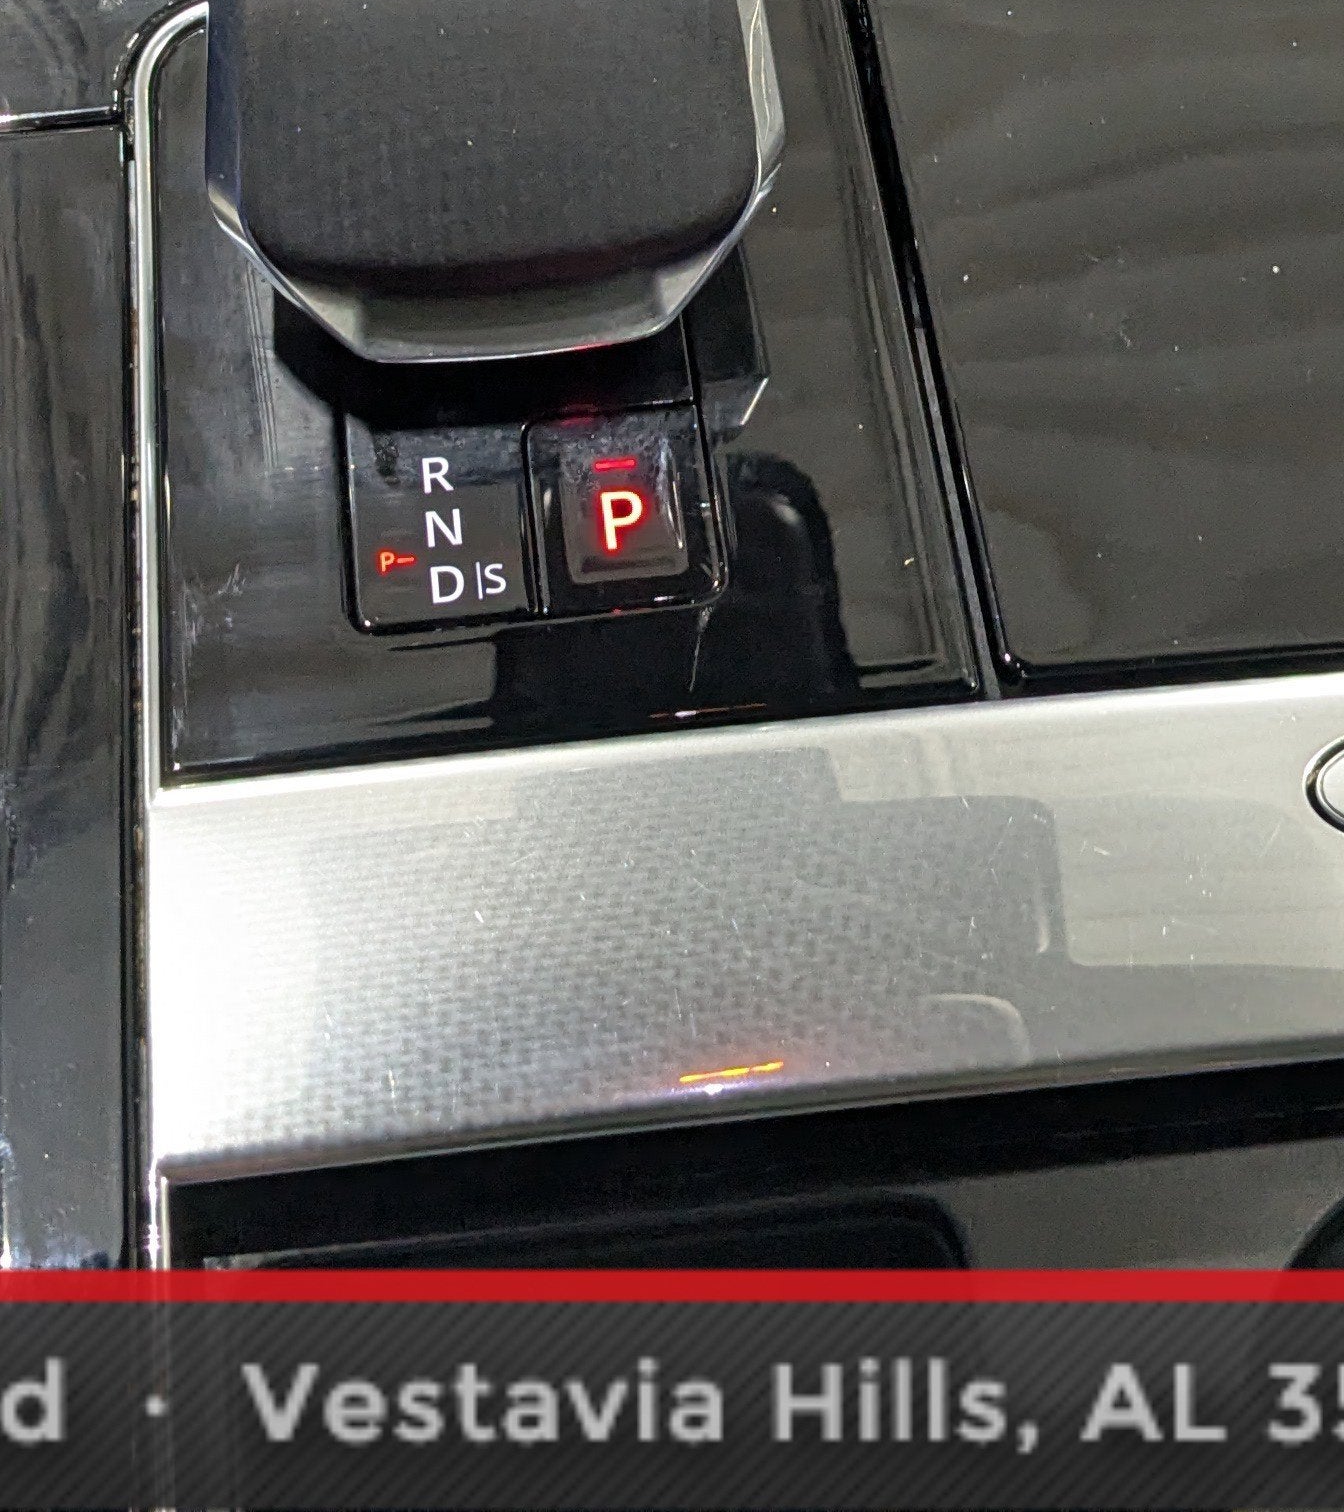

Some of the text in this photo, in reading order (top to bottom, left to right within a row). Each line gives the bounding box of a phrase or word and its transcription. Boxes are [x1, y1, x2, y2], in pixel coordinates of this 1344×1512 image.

[422, 457, 453, 493] R
[426, 509, 462, 547] N
[600, 490, 643, 551] P
